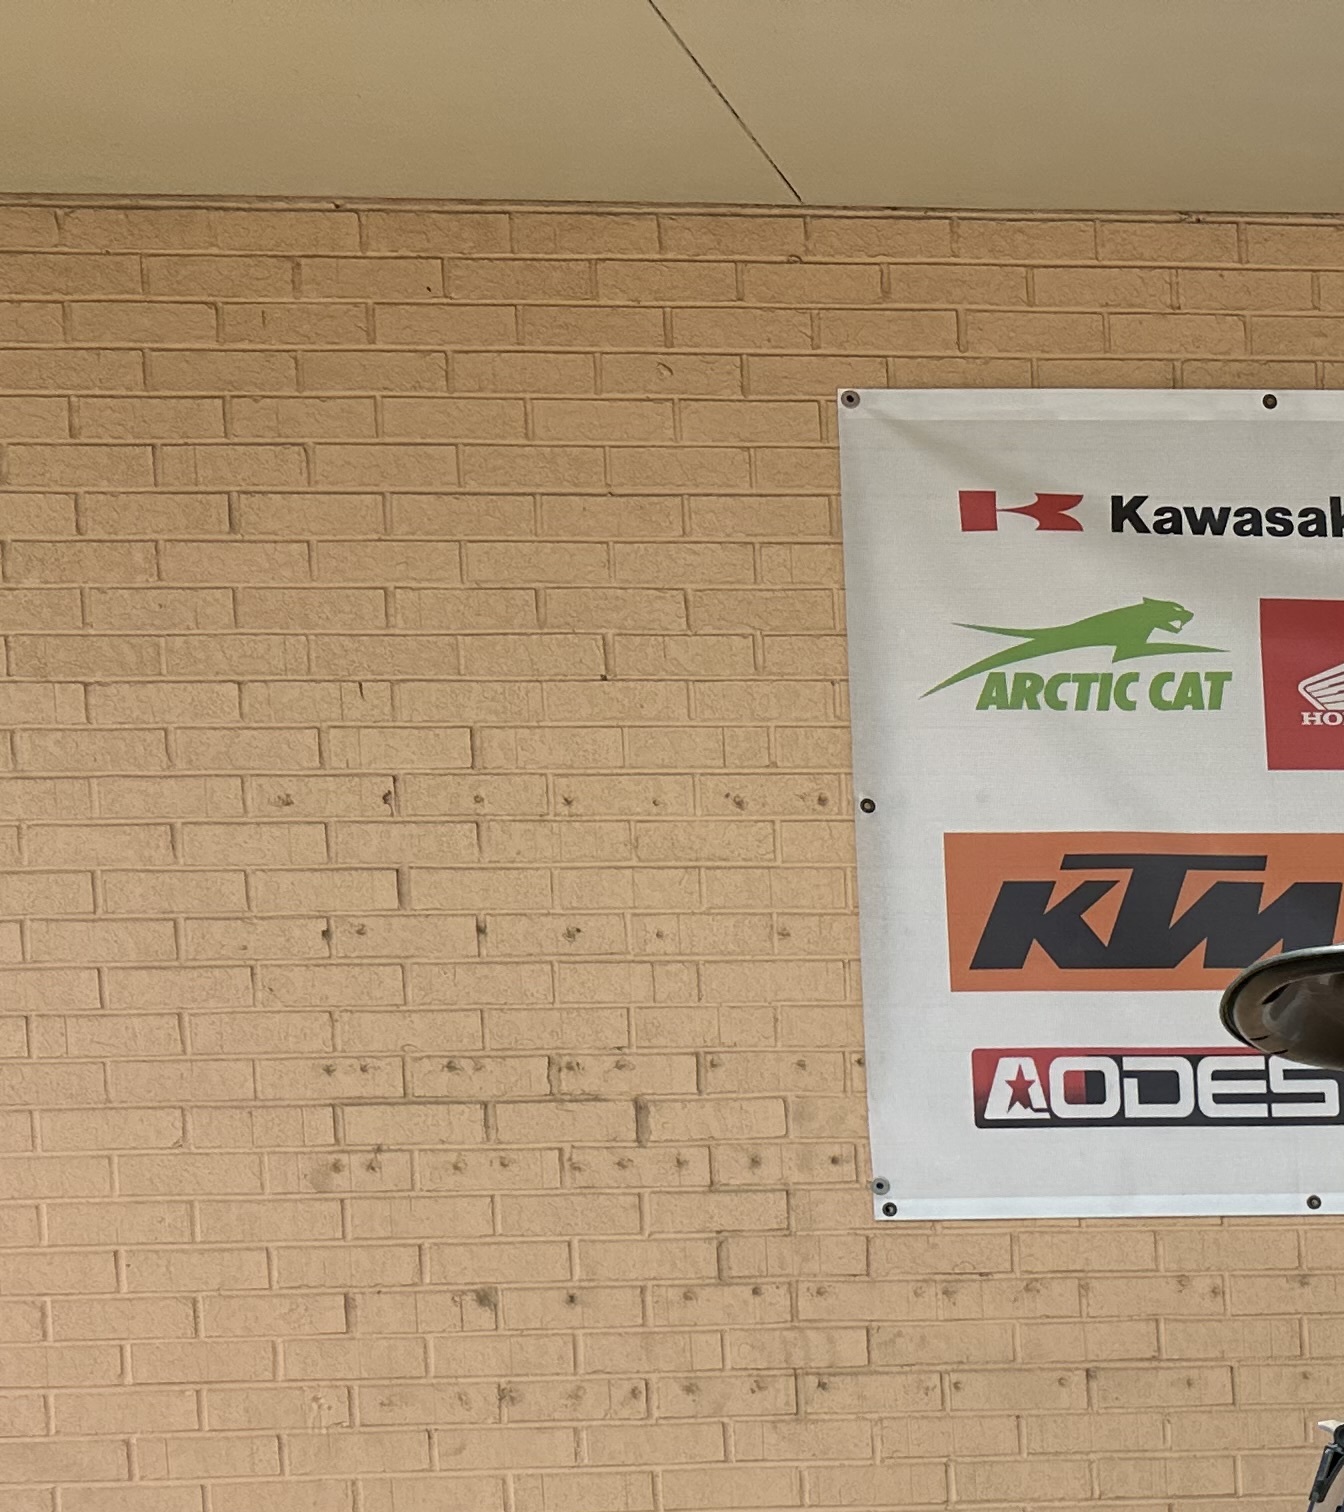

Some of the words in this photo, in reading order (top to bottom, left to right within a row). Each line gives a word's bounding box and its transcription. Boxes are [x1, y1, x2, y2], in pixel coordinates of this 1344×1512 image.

[975, 670, 1139, 712] ARCTIC
[1148, 670, 1233, 712] CAT
[968, 853, 1344, 970] KTM
[983, 1055, 1340, 1120] AODES
